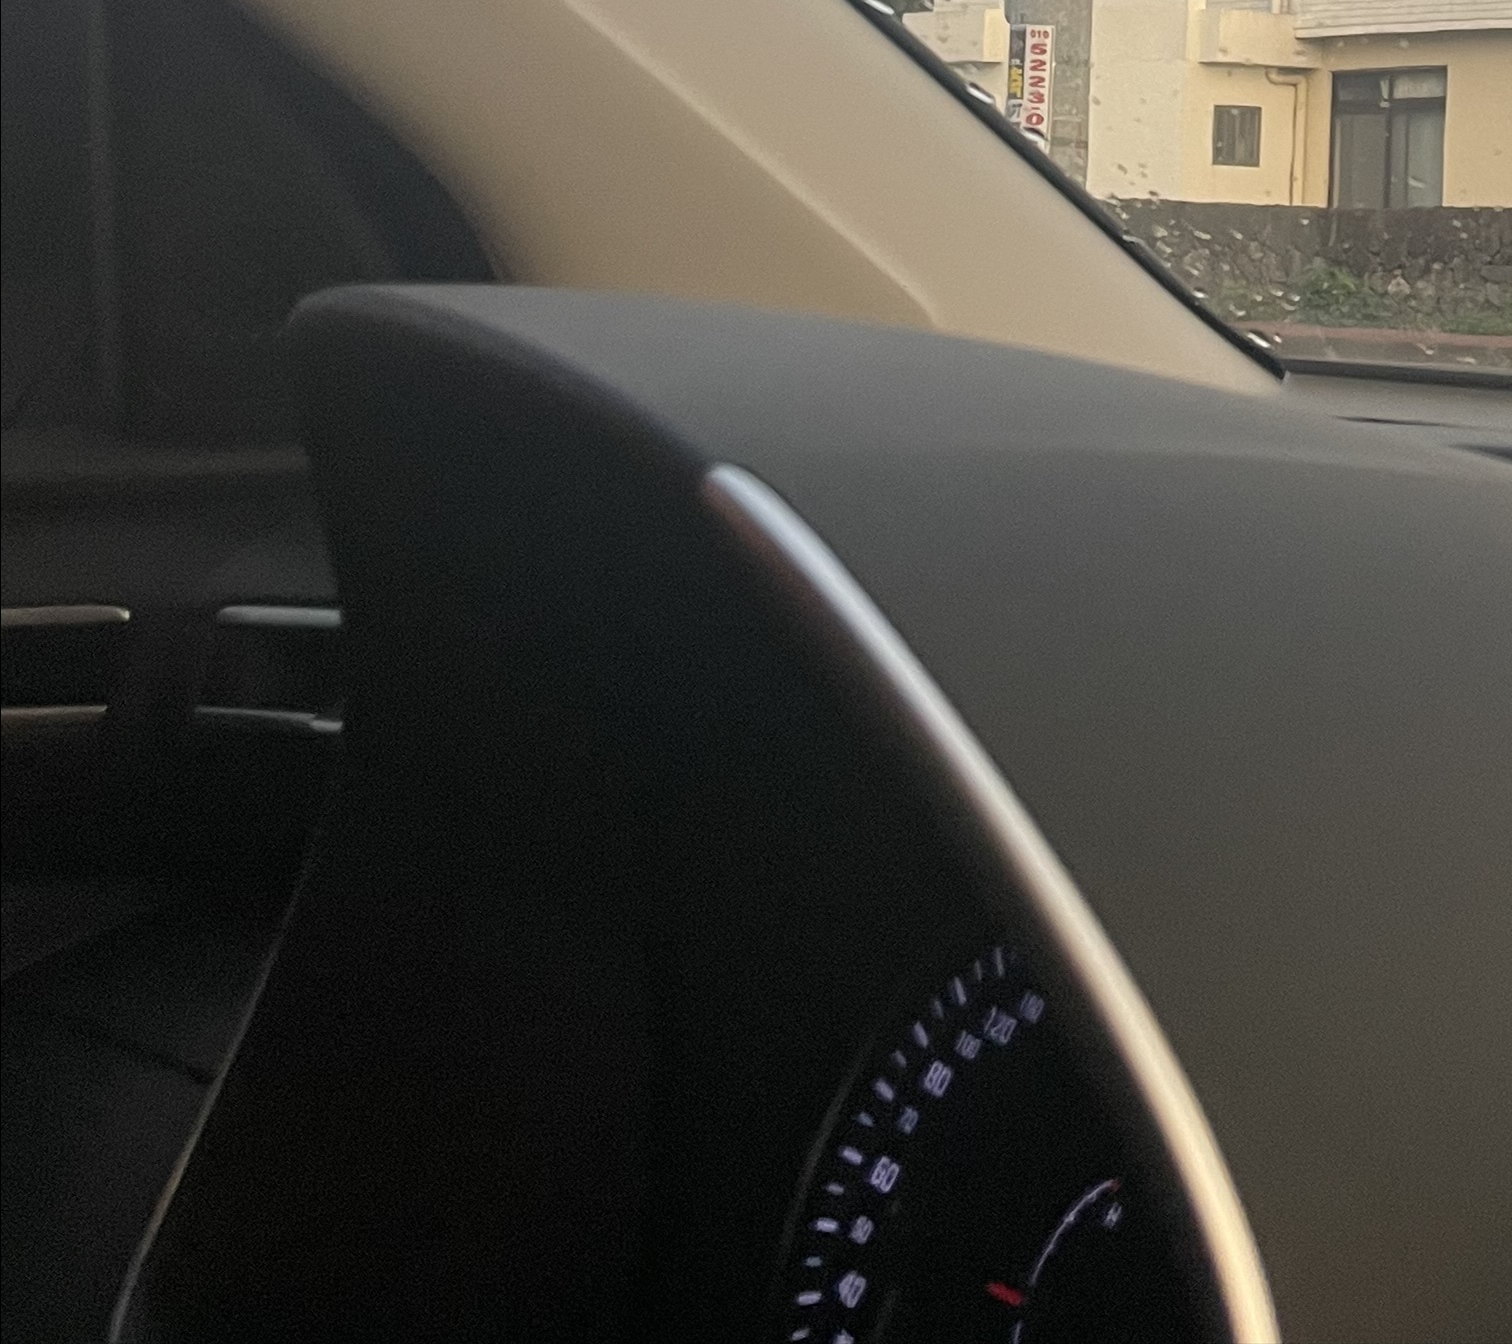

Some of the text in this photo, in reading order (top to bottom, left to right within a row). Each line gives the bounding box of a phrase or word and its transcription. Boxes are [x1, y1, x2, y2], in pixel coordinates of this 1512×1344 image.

[1030, 29, 1049, 39] 010
[924, 1060, 951, 1097] 80
[871, 1156, 900, 1193] 60
